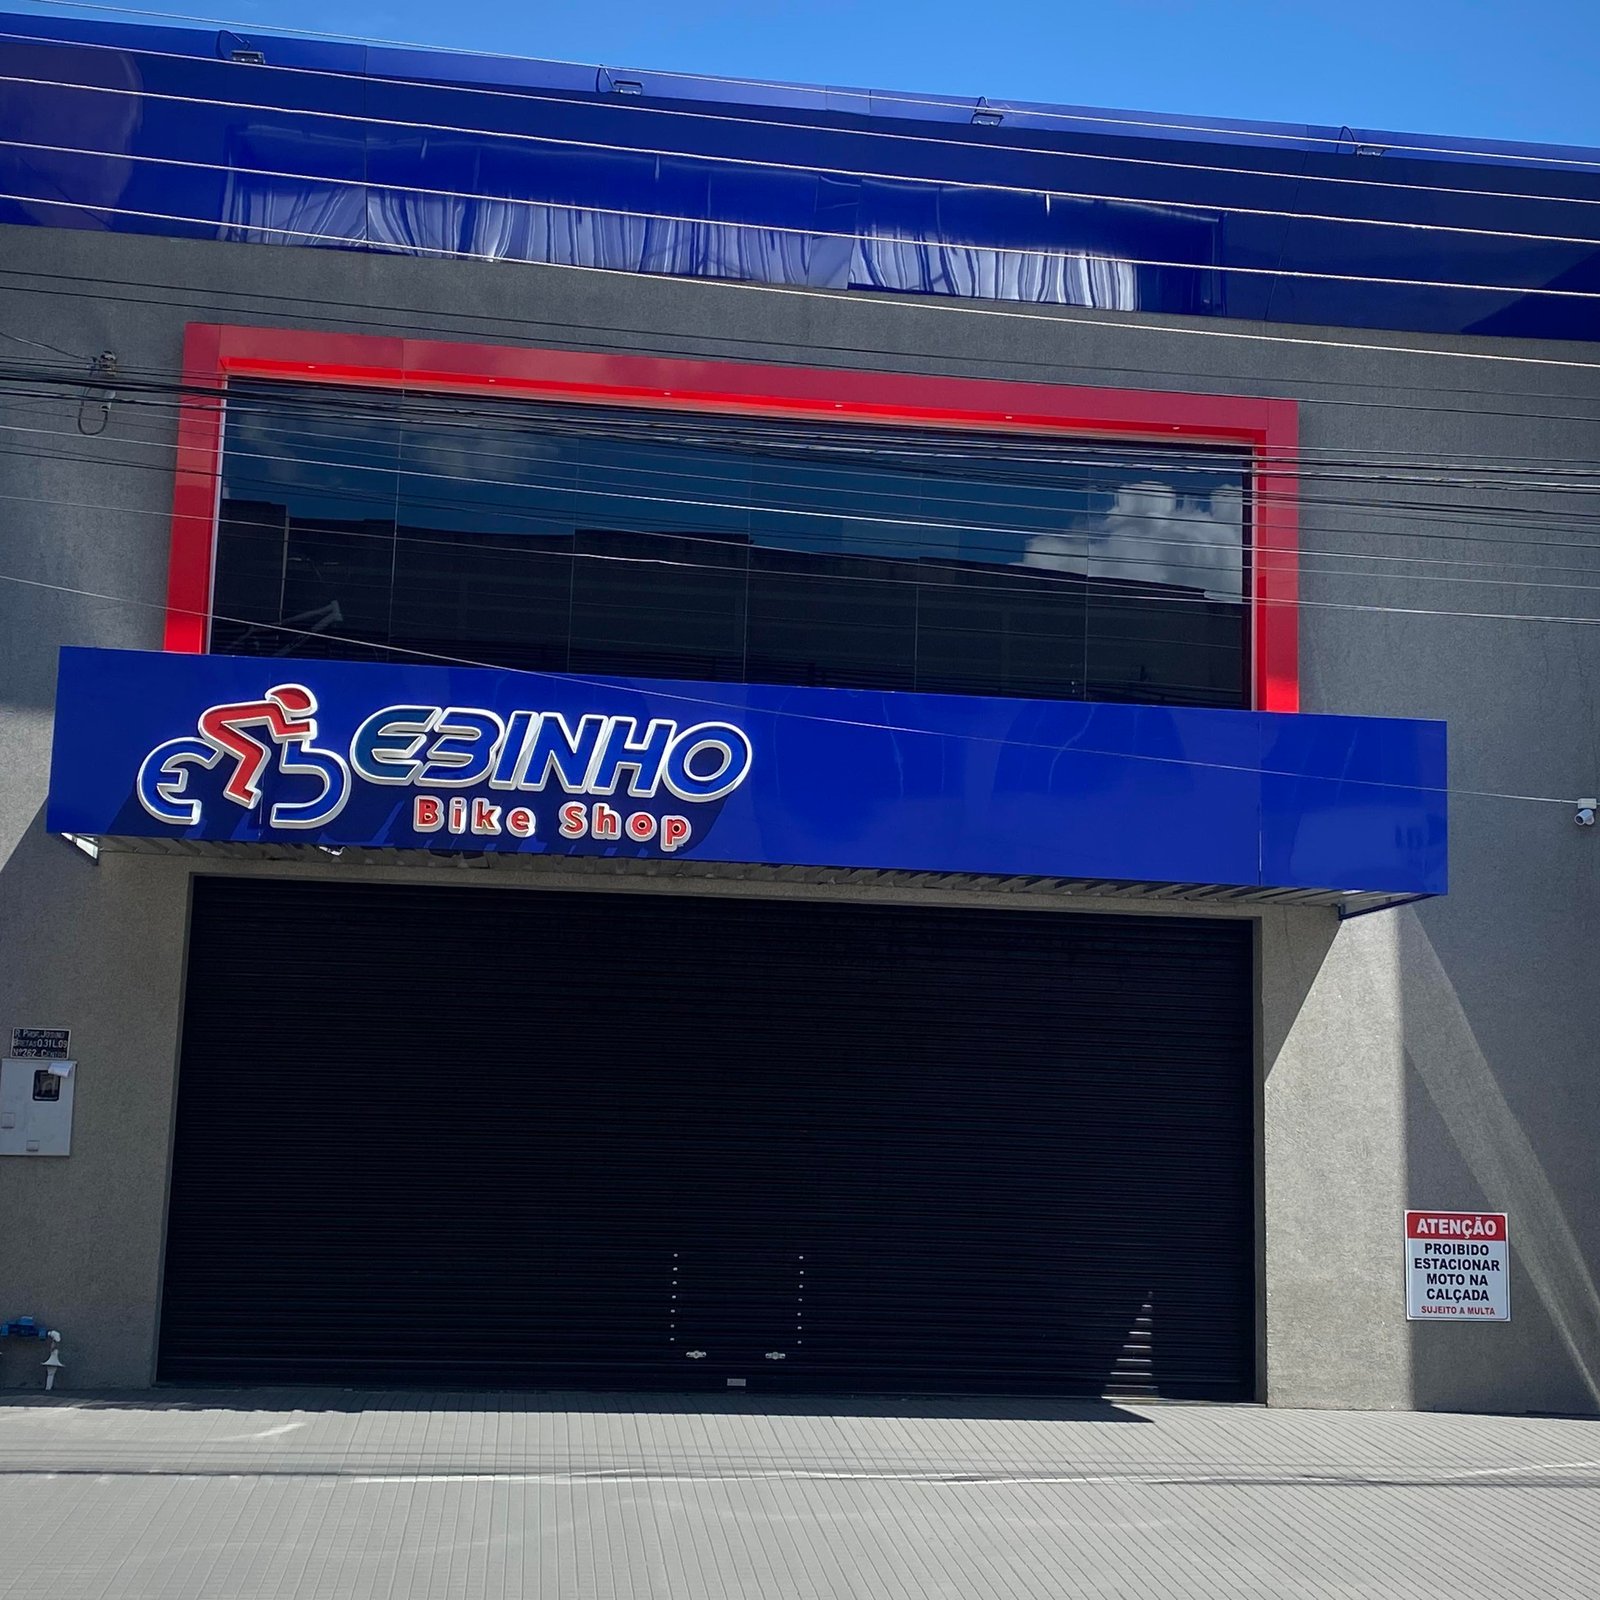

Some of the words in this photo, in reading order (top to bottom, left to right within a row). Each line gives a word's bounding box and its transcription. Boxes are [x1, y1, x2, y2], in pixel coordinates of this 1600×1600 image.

[350, 704, 752, 802] EBINHO
[413, 795, 535, 837] Bike
[559, 801, 692, 852] Shop
[1416, 1216, 1497, 1239] ATENÇÃO
[1424, 1243, 1490, 1256] PROIBIDO
[1414, 1258, 1500, 1271] ESTACIONAR
[1426, 1273, 1465, 1286] MOTO
[1469, 1274, 1488, 1286] NA
[1426, 1288, 1490, 1303] CALÇADA
[1421, 1305, 1457, 1315] SUJEITO
[1459, 1307, 1466, 1315] A
[1467, 1307, 1496, 1316] MULTA
